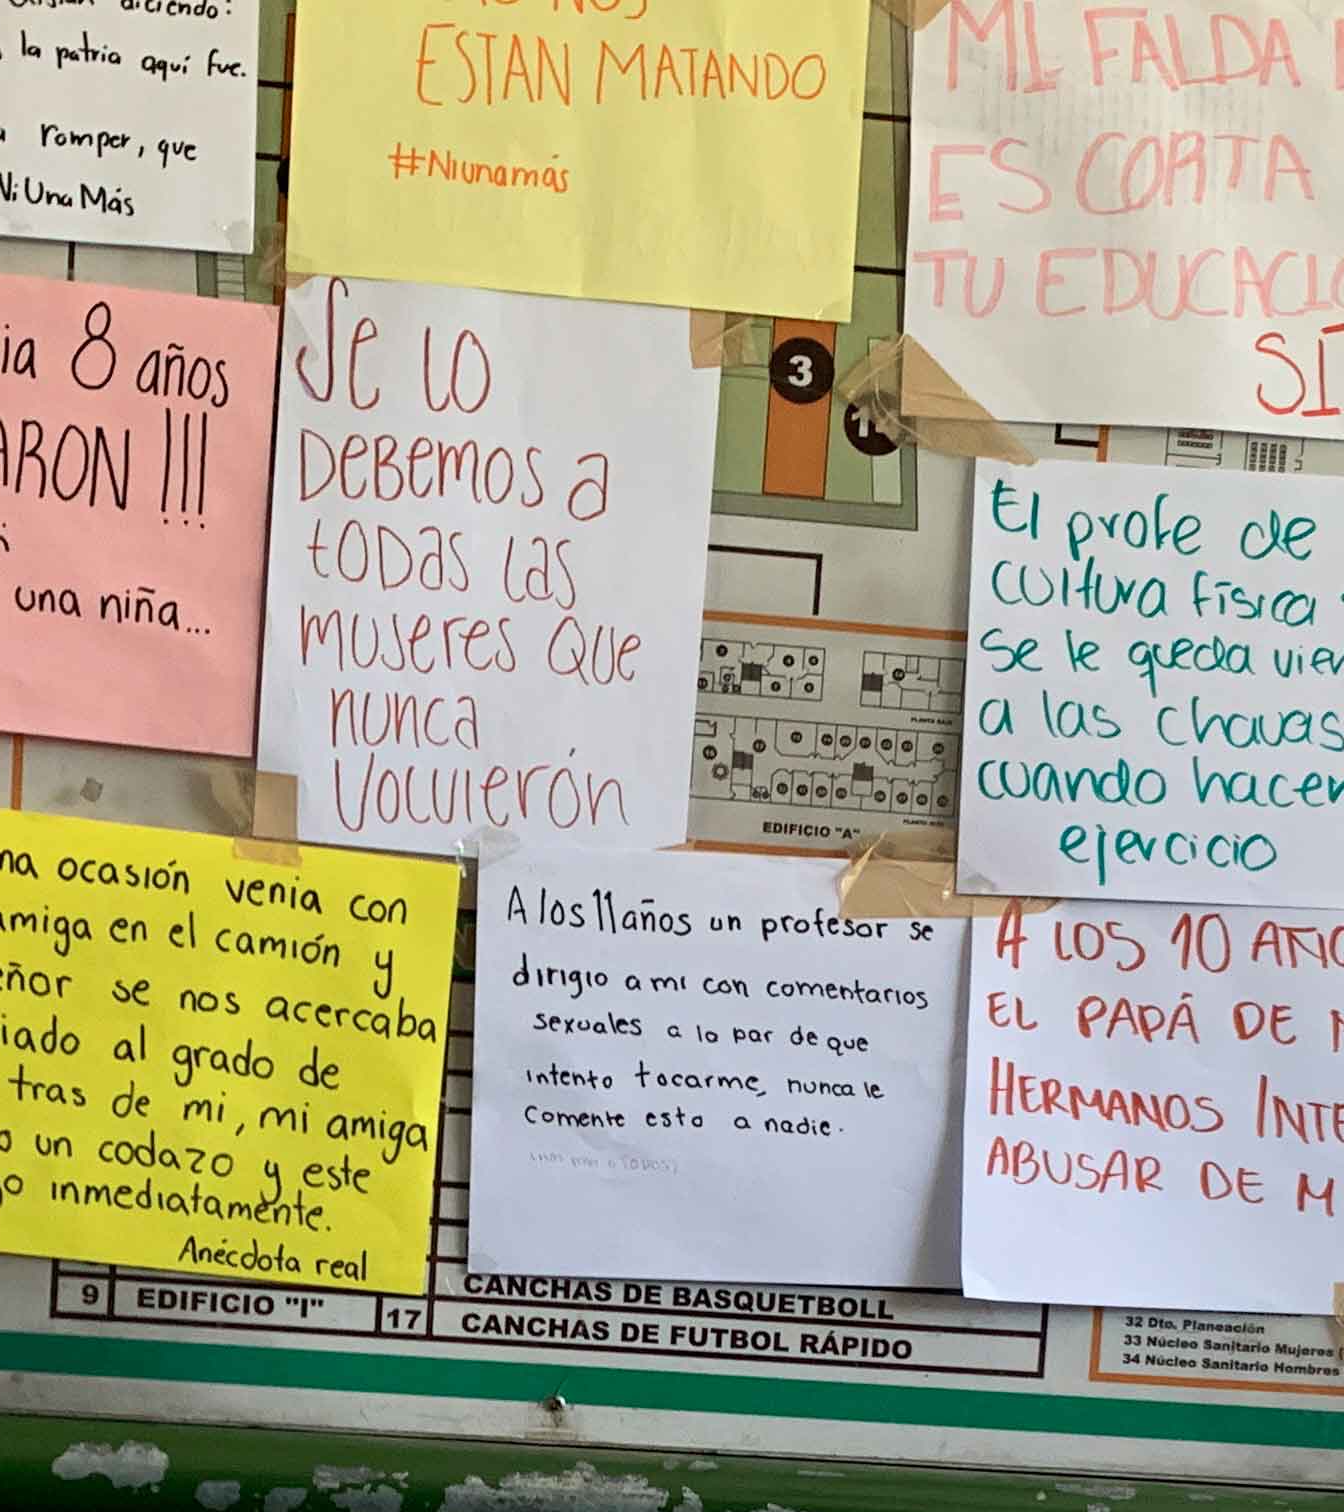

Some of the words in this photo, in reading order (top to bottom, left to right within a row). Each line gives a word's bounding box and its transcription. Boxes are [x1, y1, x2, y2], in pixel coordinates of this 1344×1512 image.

[21, 30, 41, 58] la
[57, 40, 121, 68] patria
[141, 55, 191, 82] aquí
[207, 47, 246, 78] fue.
[416, 23, 571, 106] ESTAN
[597, 40, 826, 105] MATANDO
[928, 139, 1050, 223] ES
[1075, 133, 1316, 209] CORTA
[914, 248, 1004, 320] TU
[70, 302, 115, 390] 8
[136, 340, 230, 408] años
[788, 355, 813, 387] 3
[159, 407, 211, 527] !!!
[991, 477, 1040, 537] El
[1068, 492, 1202, 559] profe
[1240, 513, 1316, 564] de
[14, 582, 81, 618] una
[763, 821, 830, 838] EDIFICIO
[835, 827, 861, 840] "A"
[56, 853, 191, 896] ocasión
[349, 888, 409, 926] con
[995, 900, 1029, 970] A
[1055, 914, 1145, 972] LOS
[1171, 913, 1227, 973] 10
[988, 991, 1038, 1031] EL
[1077, 988, 1201, 1042] PAPÁ
[1234, 1001, 1296, 1044] DE
[81, 1284, 99, 1304] 9
[137, 1288, 274, 1316] EDIFICIO
[284, 1296, 323, 1319] "I"
[464, 1274, 612, 1303] CANCHAS
[624, 1283, 661, 1305] DE
[671, 1286, 894, 1320] BASQUETBOLL
[389, 1308, 422, 1331] 17
[462, 1313, 609, 1341] CANCHAS
[621, 1321, 659, 1344] DE
[669, 1325, 789, 1353] FUTBOL
[800, 1329, 912, 1360] RÁPIDO
[1125, 1316, 1142, 1327] 32
[1148, 1317, 1178, 1330] Dto.
[1182, 1320, 1265, 1335] Planeación
[1122, 1354, 1140, 1365] 34
[1145, 1355, 1196, 1369] Núcleo
[1202, 1358, 1268, 1373] Sanitario
[1274, 1363, 1340, 1378] Hombres
